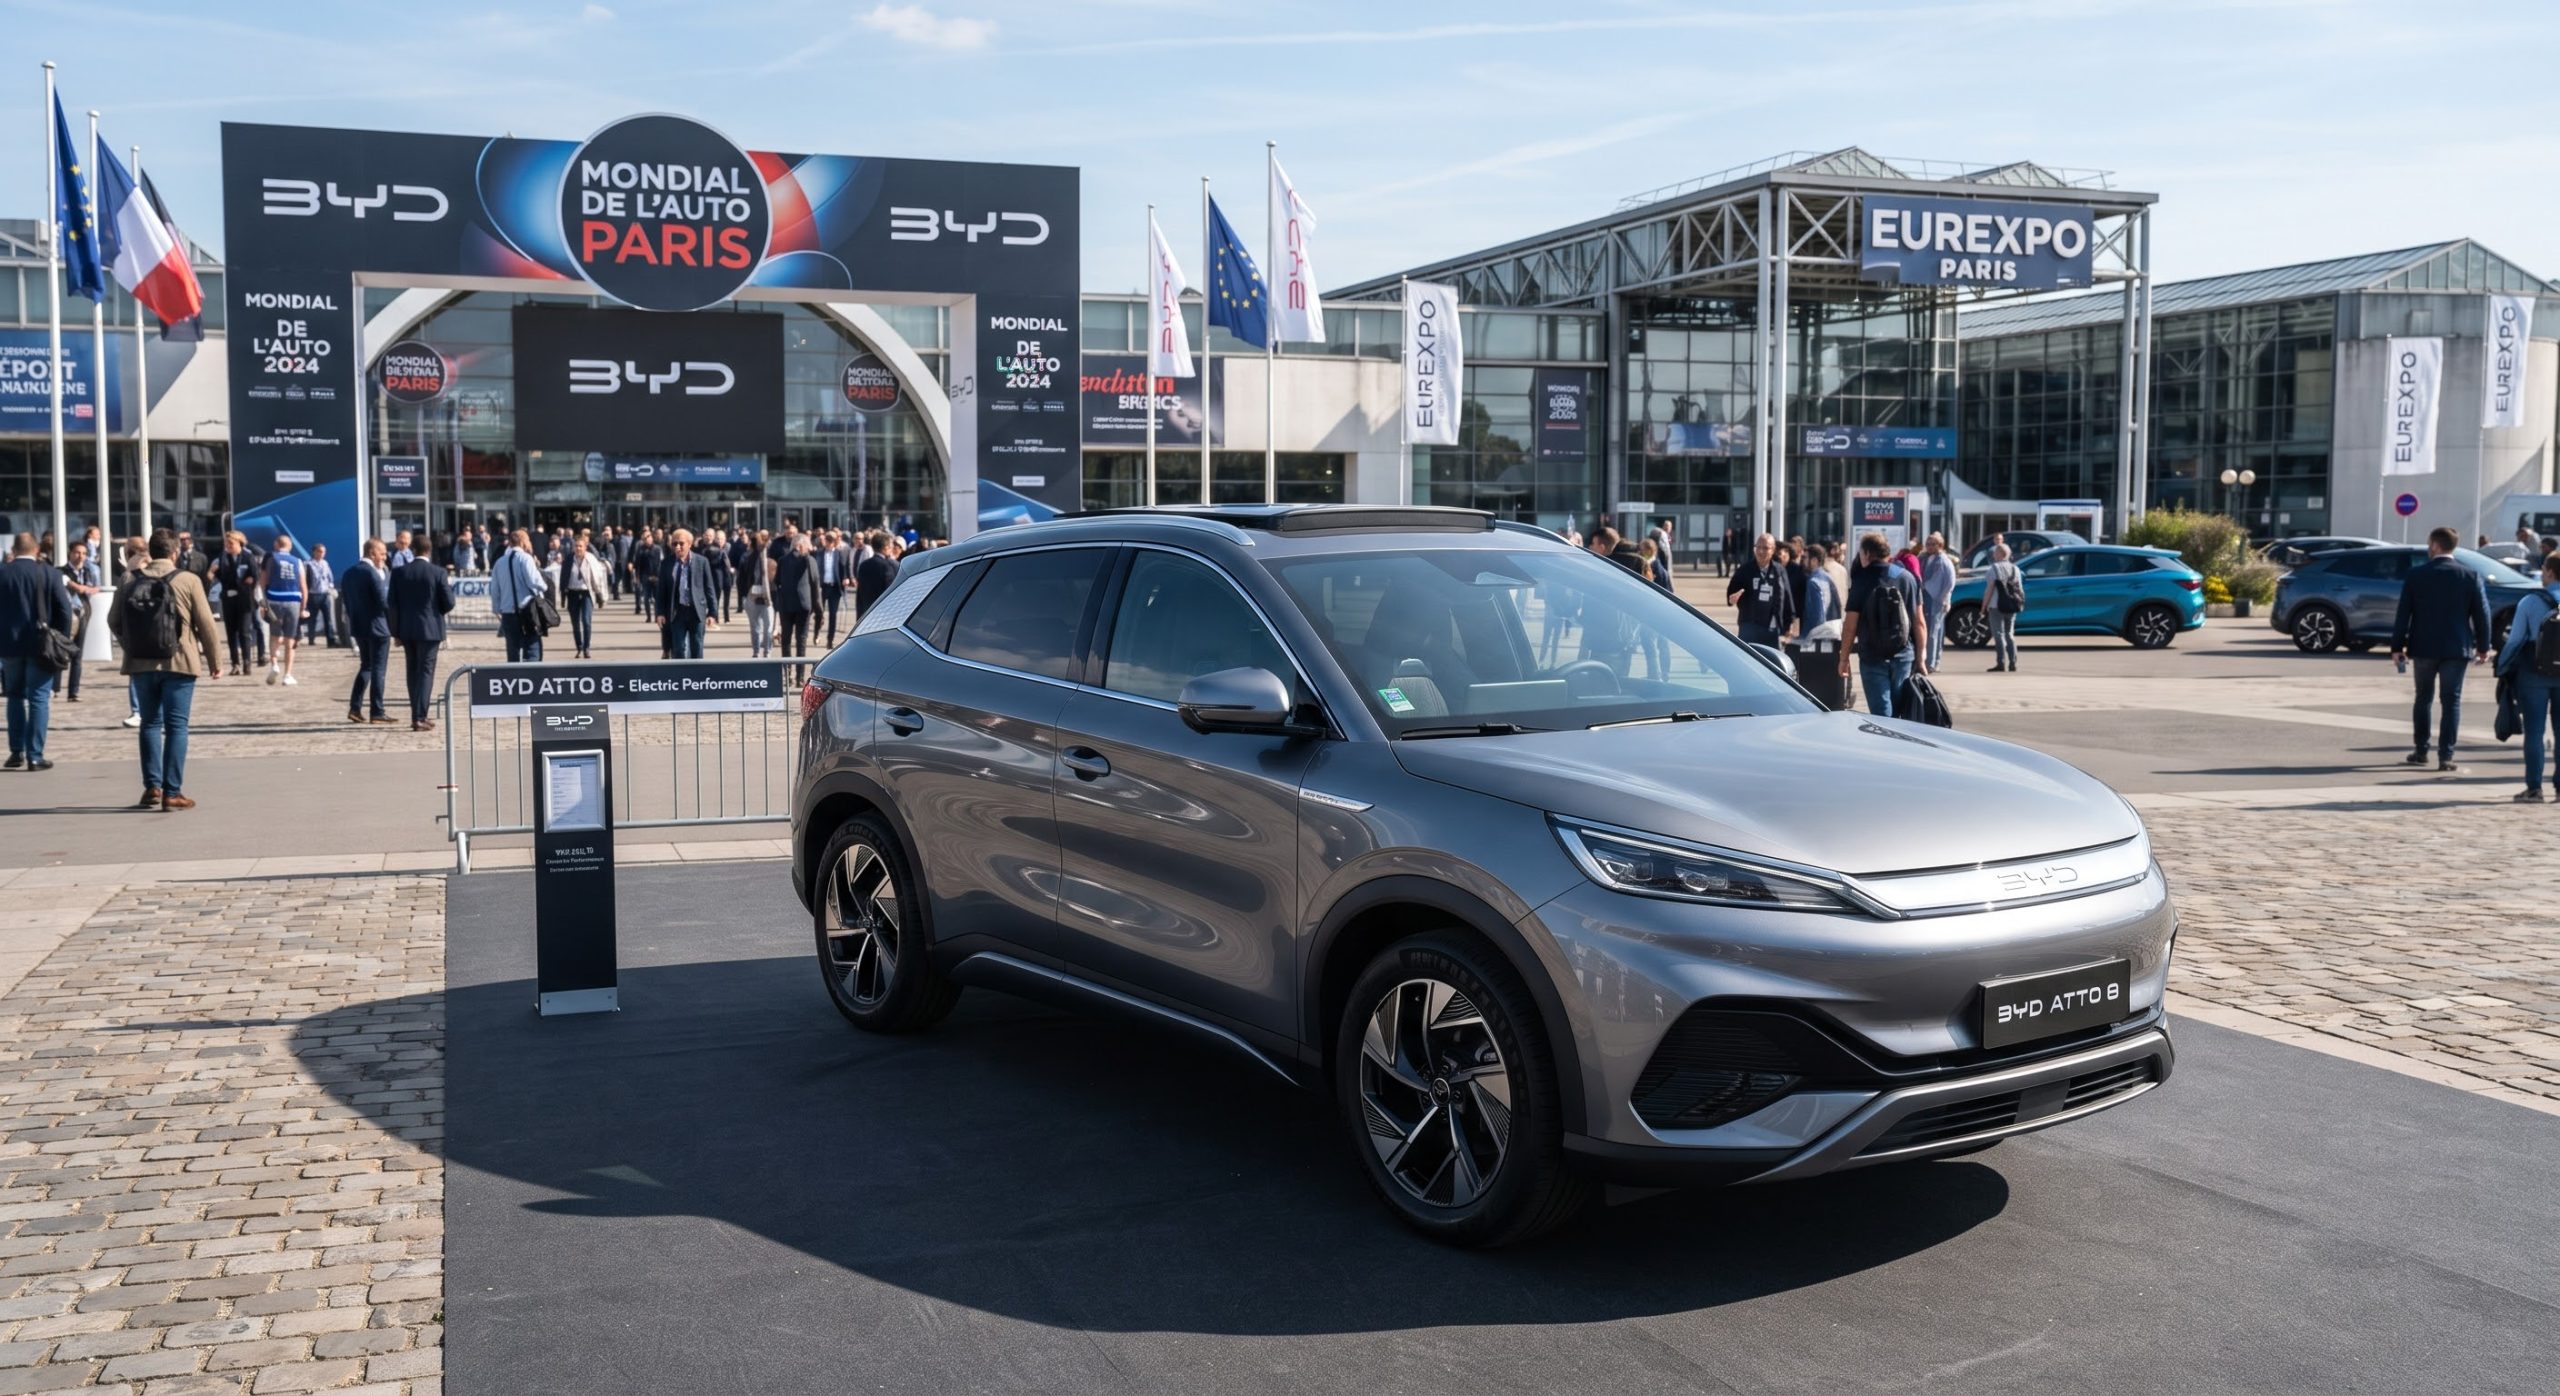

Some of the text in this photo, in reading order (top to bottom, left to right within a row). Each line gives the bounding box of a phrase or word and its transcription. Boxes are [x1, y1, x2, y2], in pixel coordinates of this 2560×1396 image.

[582, 160, 750, 194] MONDIAL
[262, 178, 449, 222] BYD
[582, 190, 626, 217] DE
[890, 206, 1050, 245] BYD
[1872, 208, 2087, 259] EUREXPO
[582, 220, 751, 269] PARIS
[1940, 258, 2017, 281] PARIS
[245, 292, 338, 310] MONDIAL
[277, 319, 307, 337] DE
[991, 316, 1068, 331] MONDIAL
[253, 338, 331, 356] L'AUTO
[1017, 340, 1041, 356] DE
[0, 357, 77, 380] ÉPOT
[264, 356, 320, 374] 2024
[385, 355, 439, 367] MONDIAL
[1417, 300, 1436, 427] EUREXPO
[2496, 306, 2516, 412] EUREXPO
[386, 376, 440, 391] PARIS
[569, 359, 735, 395] BYD
[1006, 373, 1051, 389] 2024
[848, 386, 896, 400] PARIS
[2395, 352, 2416, 462] EUREXPO
[489, 678, 534, 696] BYD
[538, 677, 595, 695] ATTO
[601, 677, 614, 694] 8
[629, 679, 679, 693] Electric
[682, 678, 769, 691] Performence
[546, 715, 594, 726] BYD
[1997, 866, 2078, 891] BYD
[1998, 982, 2119, 1024] BYD ATTO 8
